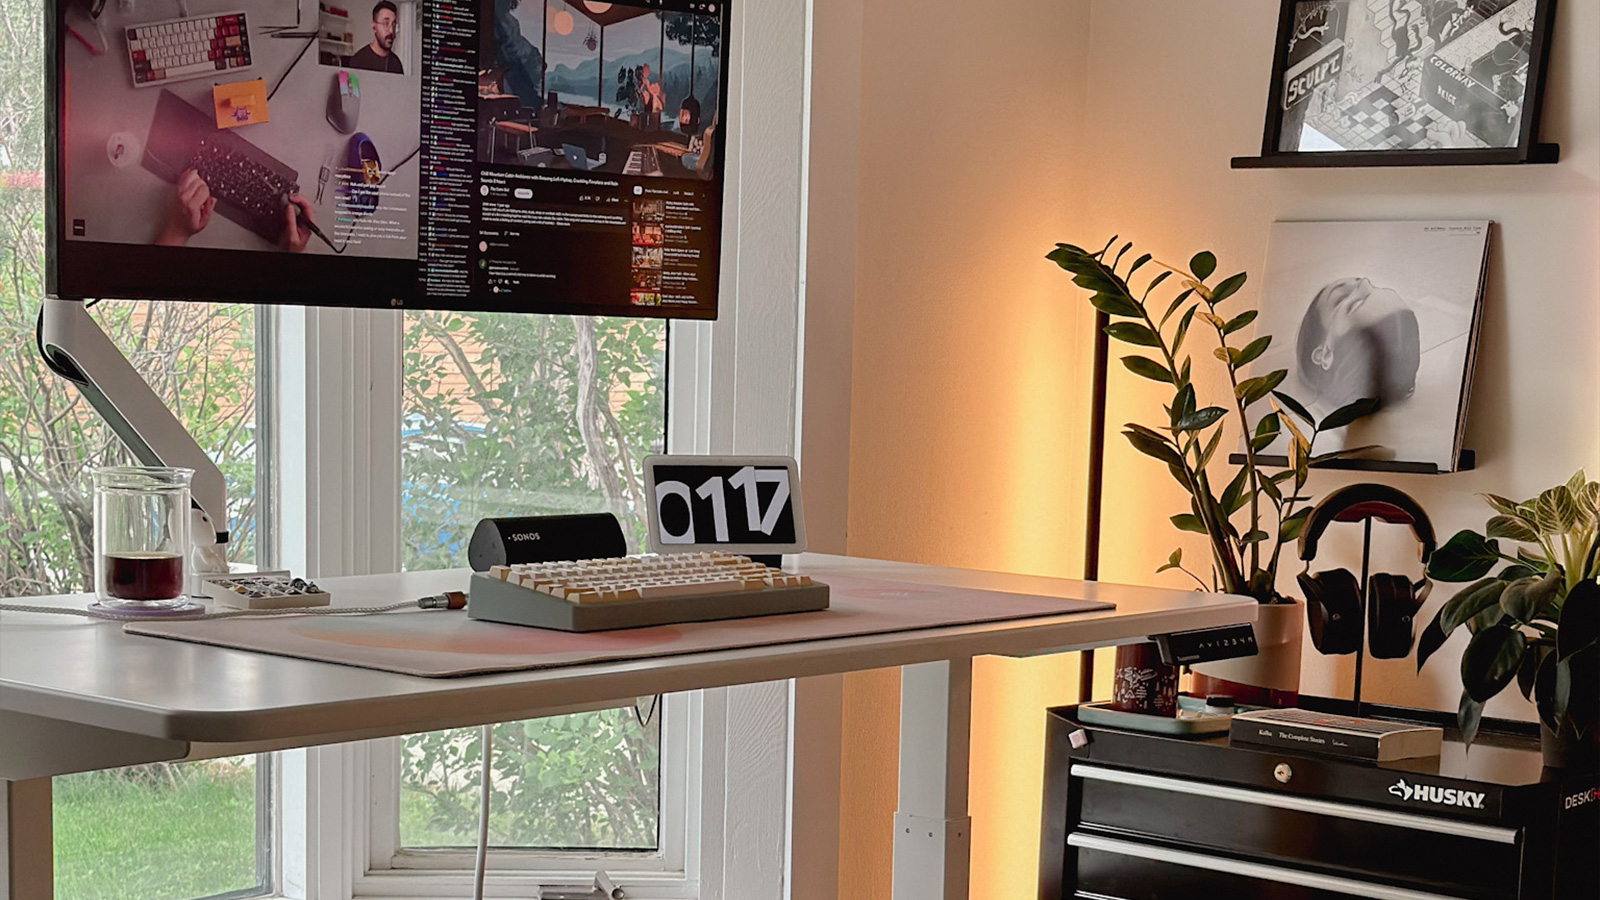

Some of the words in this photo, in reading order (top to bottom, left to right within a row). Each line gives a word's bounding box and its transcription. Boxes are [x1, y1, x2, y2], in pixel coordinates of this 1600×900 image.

[1287, 53, 1340, 103] SCULPT
[1430, 56, 1476, 88] COLORWAY
[512, 532, 540, 541] SONOS
[1413, 784, 1485, 809] HUSKY
